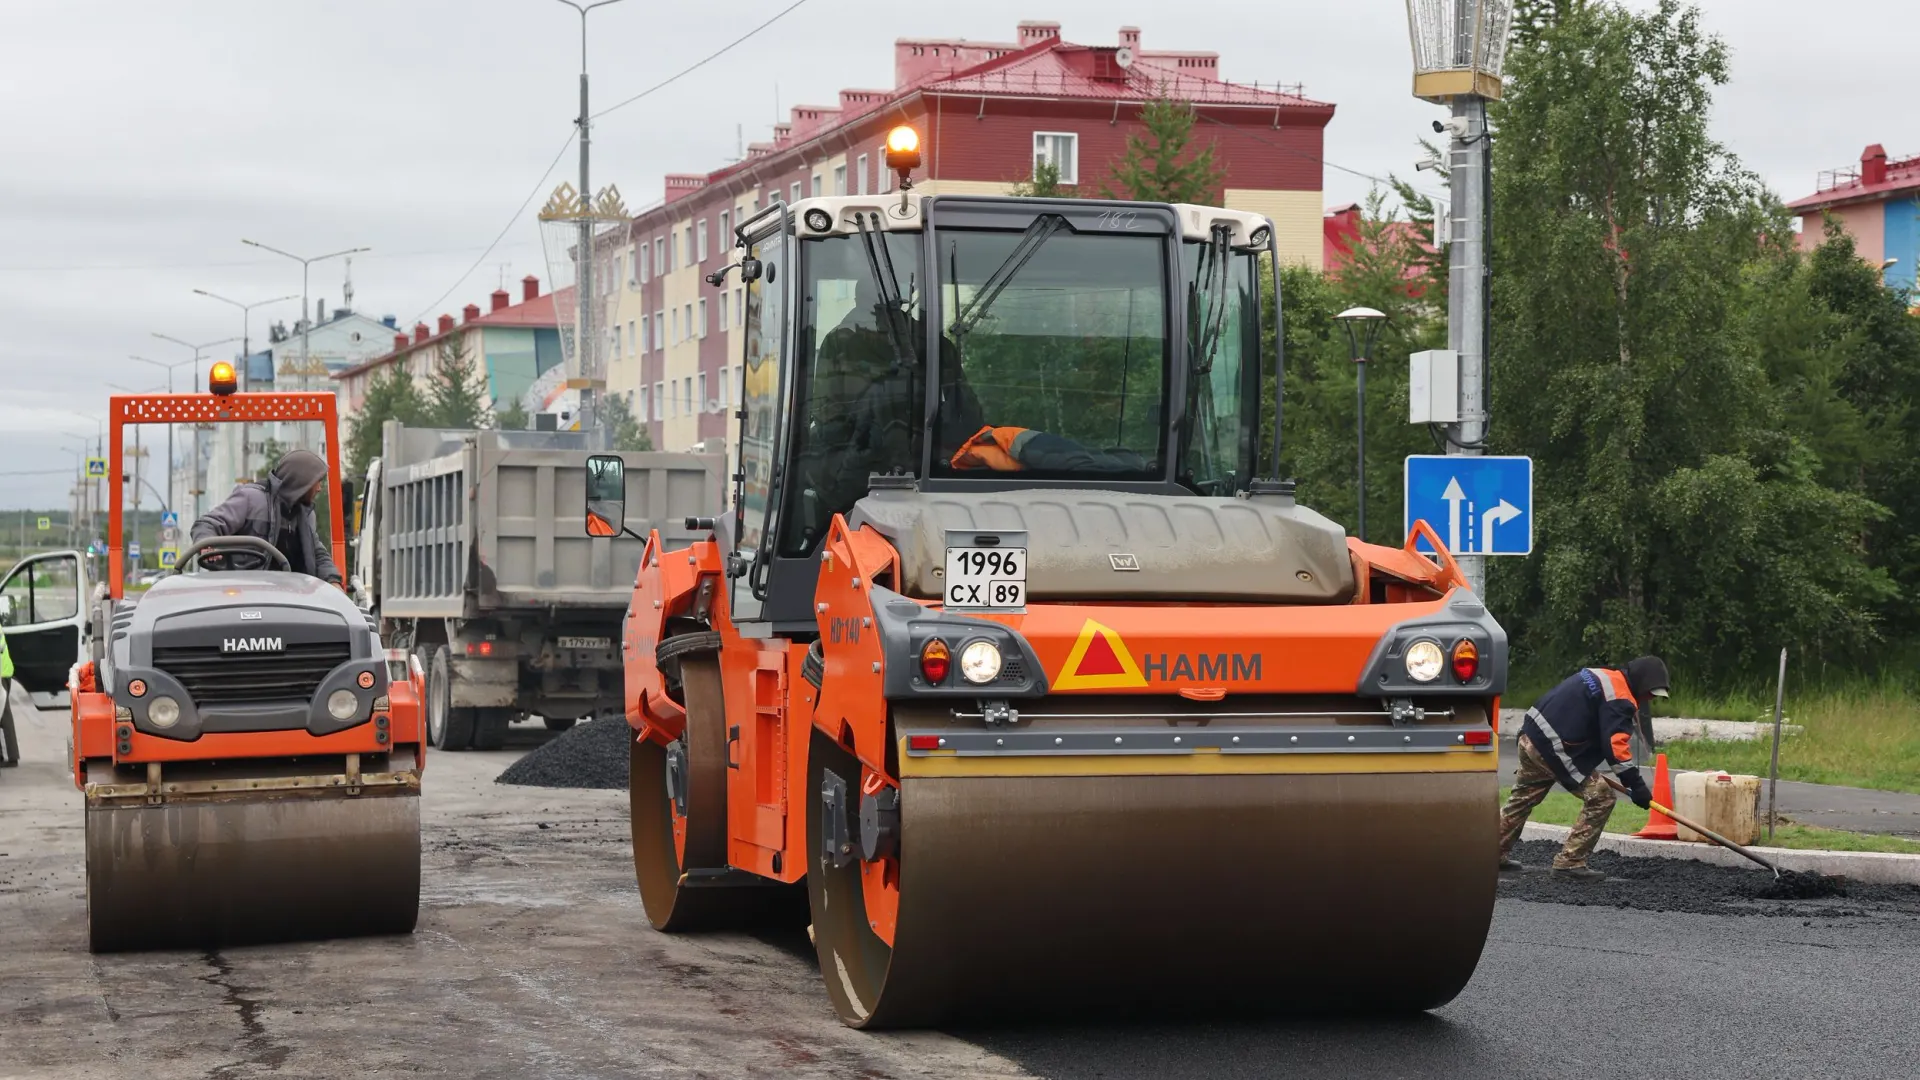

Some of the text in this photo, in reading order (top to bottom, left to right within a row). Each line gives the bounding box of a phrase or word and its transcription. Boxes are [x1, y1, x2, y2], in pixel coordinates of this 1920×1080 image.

[957, 552, 1017, 575] 1996
[951, 585, 1019, 603] СХ 89
[223, 637, 282, 652] HAMM
[1144, 653, 1262, 681] HAMM
